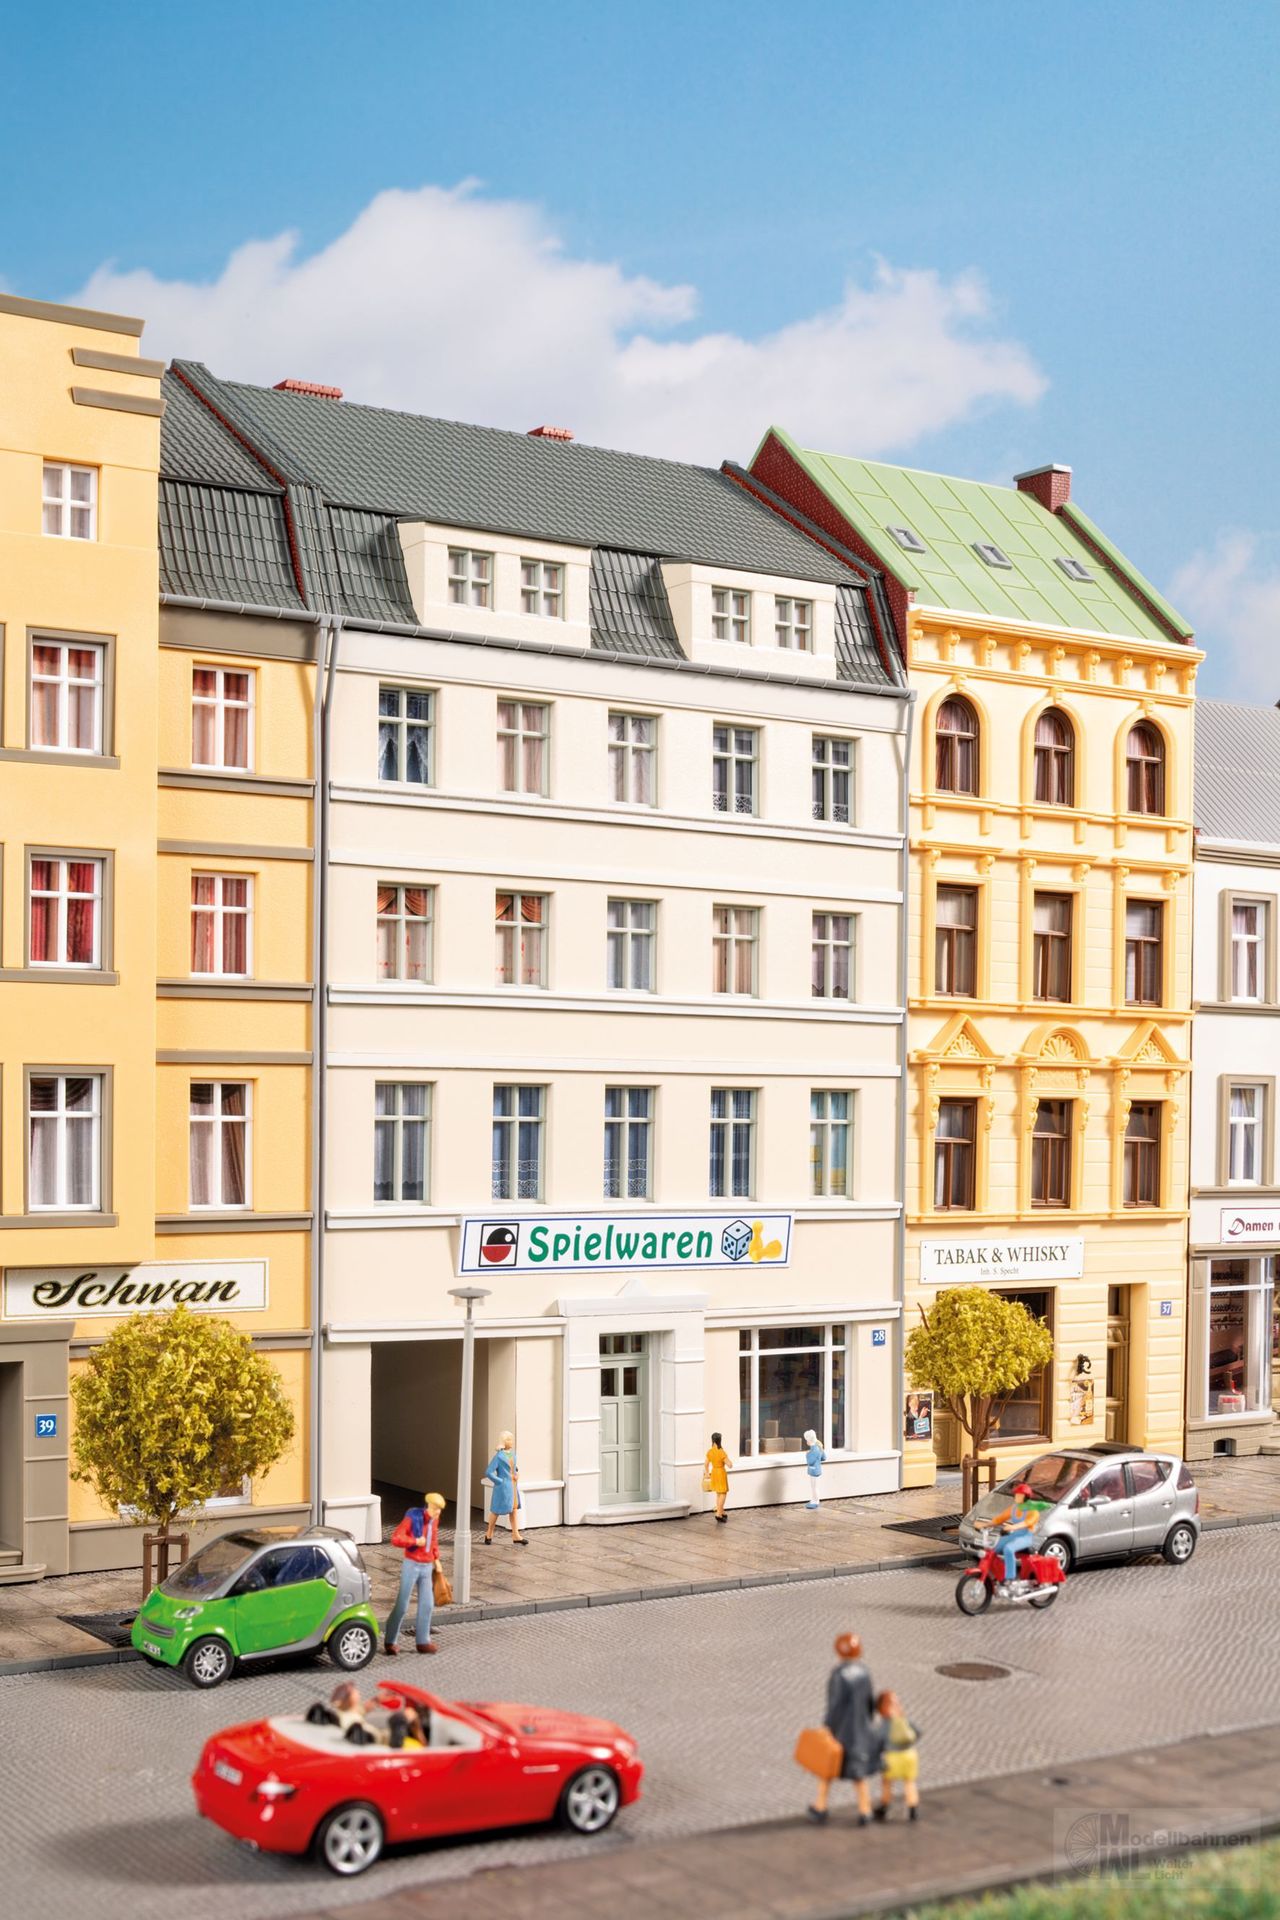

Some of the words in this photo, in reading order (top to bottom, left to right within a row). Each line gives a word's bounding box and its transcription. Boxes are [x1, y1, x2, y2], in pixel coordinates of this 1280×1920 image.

[1228, 1217, 1274, 1236] Damen
[528, 1225, 713, 1262] Spielwaren
[934, 1248, 987, 1265] TABAK
[991, 1247, 1003, 1263] &
[1007, 1245, 1070, 1262] WHISKY
[33, 1272, 240, 1308] Schwan
[873, 1330, 885, 1342] 28
[38, 1419, 55, 1434] 39
